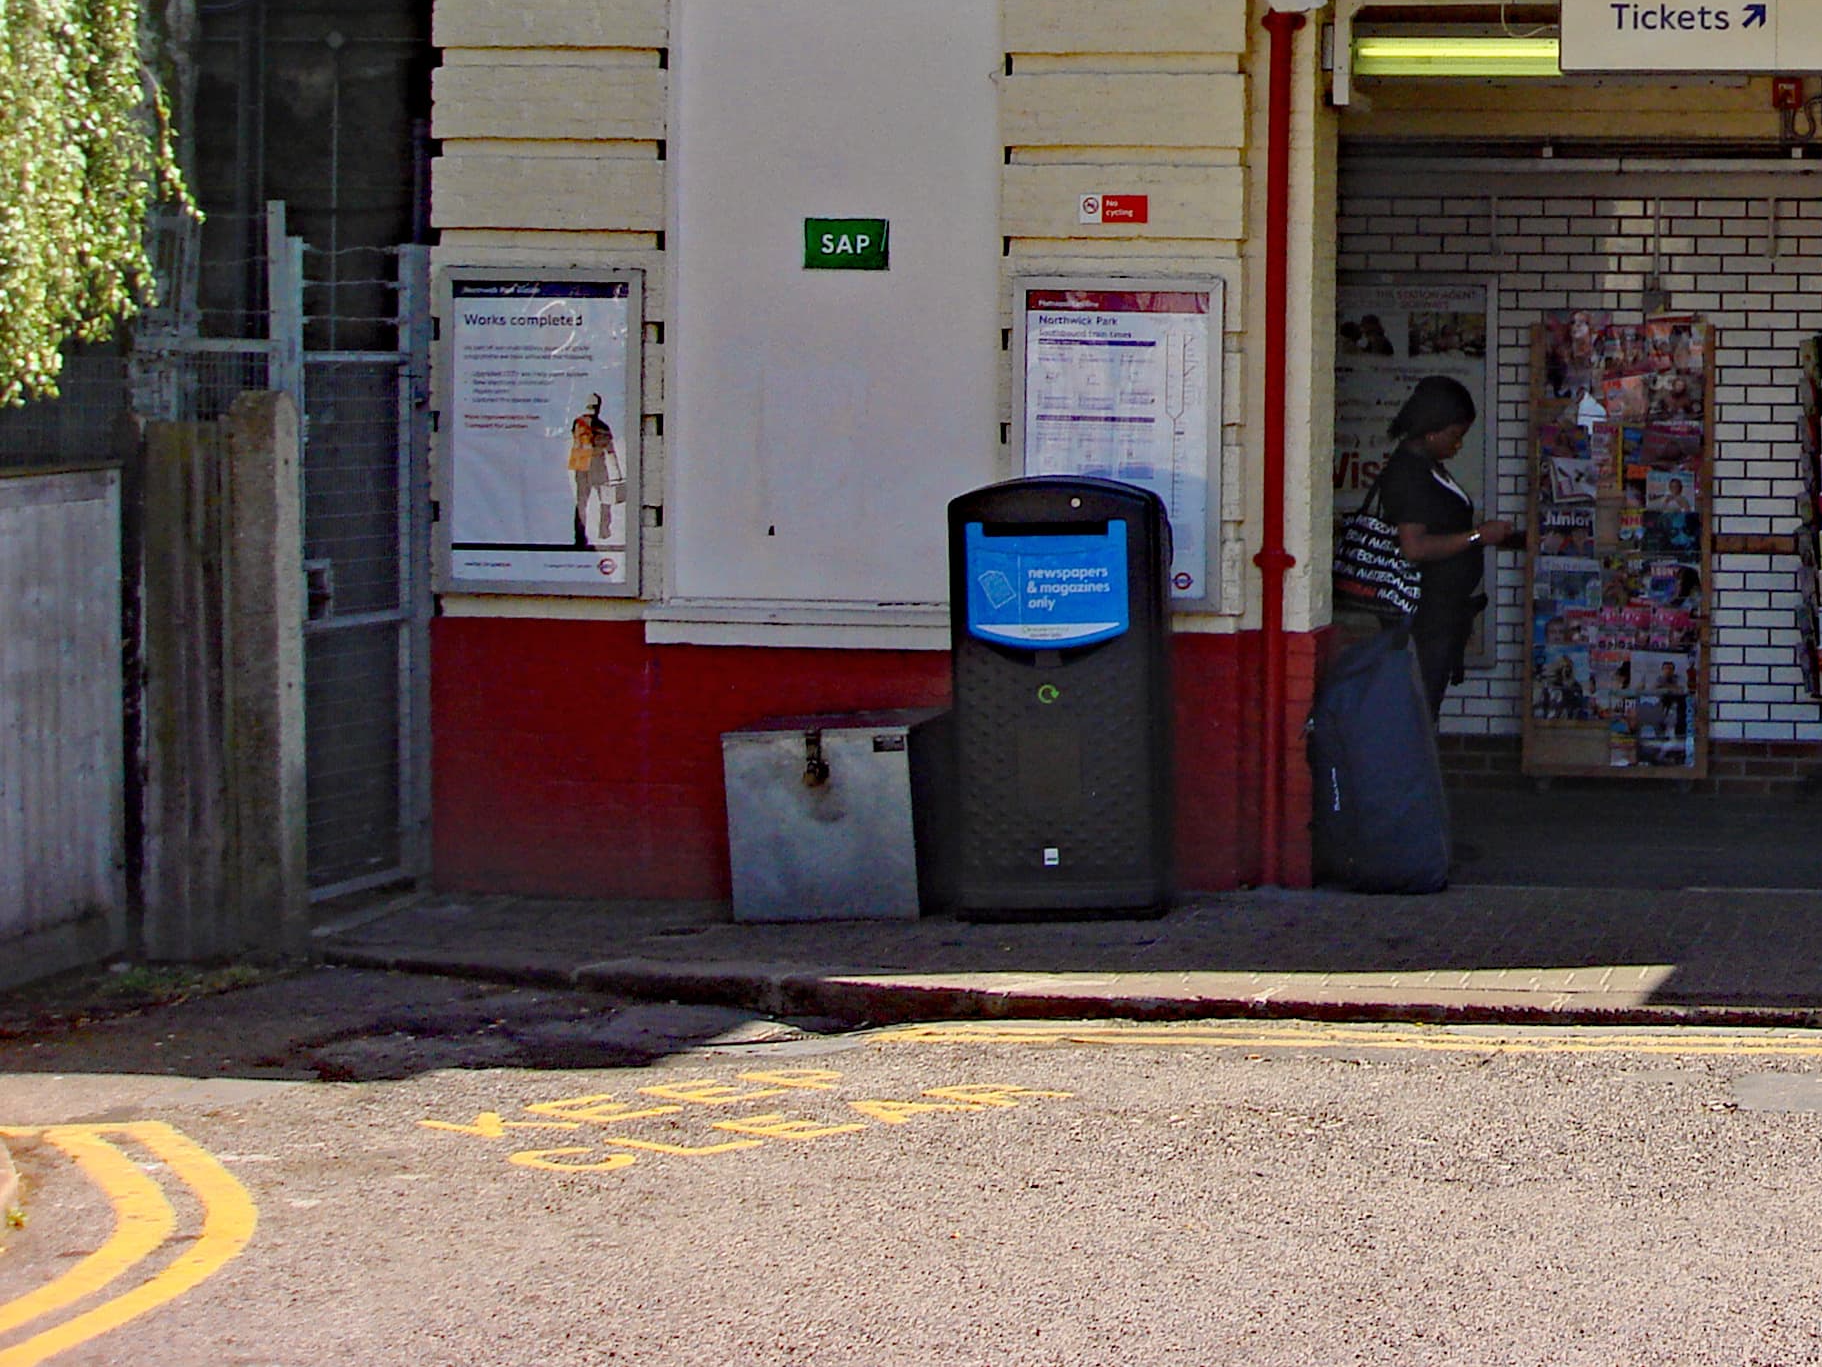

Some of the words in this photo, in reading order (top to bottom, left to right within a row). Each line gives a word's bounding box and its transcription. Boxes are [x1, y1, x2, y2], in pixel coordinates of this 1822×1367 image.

[1610, 3, 1730, 30] Tickets
[821, 233, 870, 254] SAP
[464, 314, 507, 326] Works
[510, 314, 583, 328] completed
[1039, 315, 1092, 326] Northwick
[1096, 316, 1119, 326] Park
[1028, 567, 1109, 582] newspapers
[1026, 580, 1038, 594] &
[1040, 580, 1111, 596] magazines
[1028, 596, 1057, 612] only
[415, 1068, 843, 1137] KEEP
[509, 1084, 1075, 1172] CLEAR
